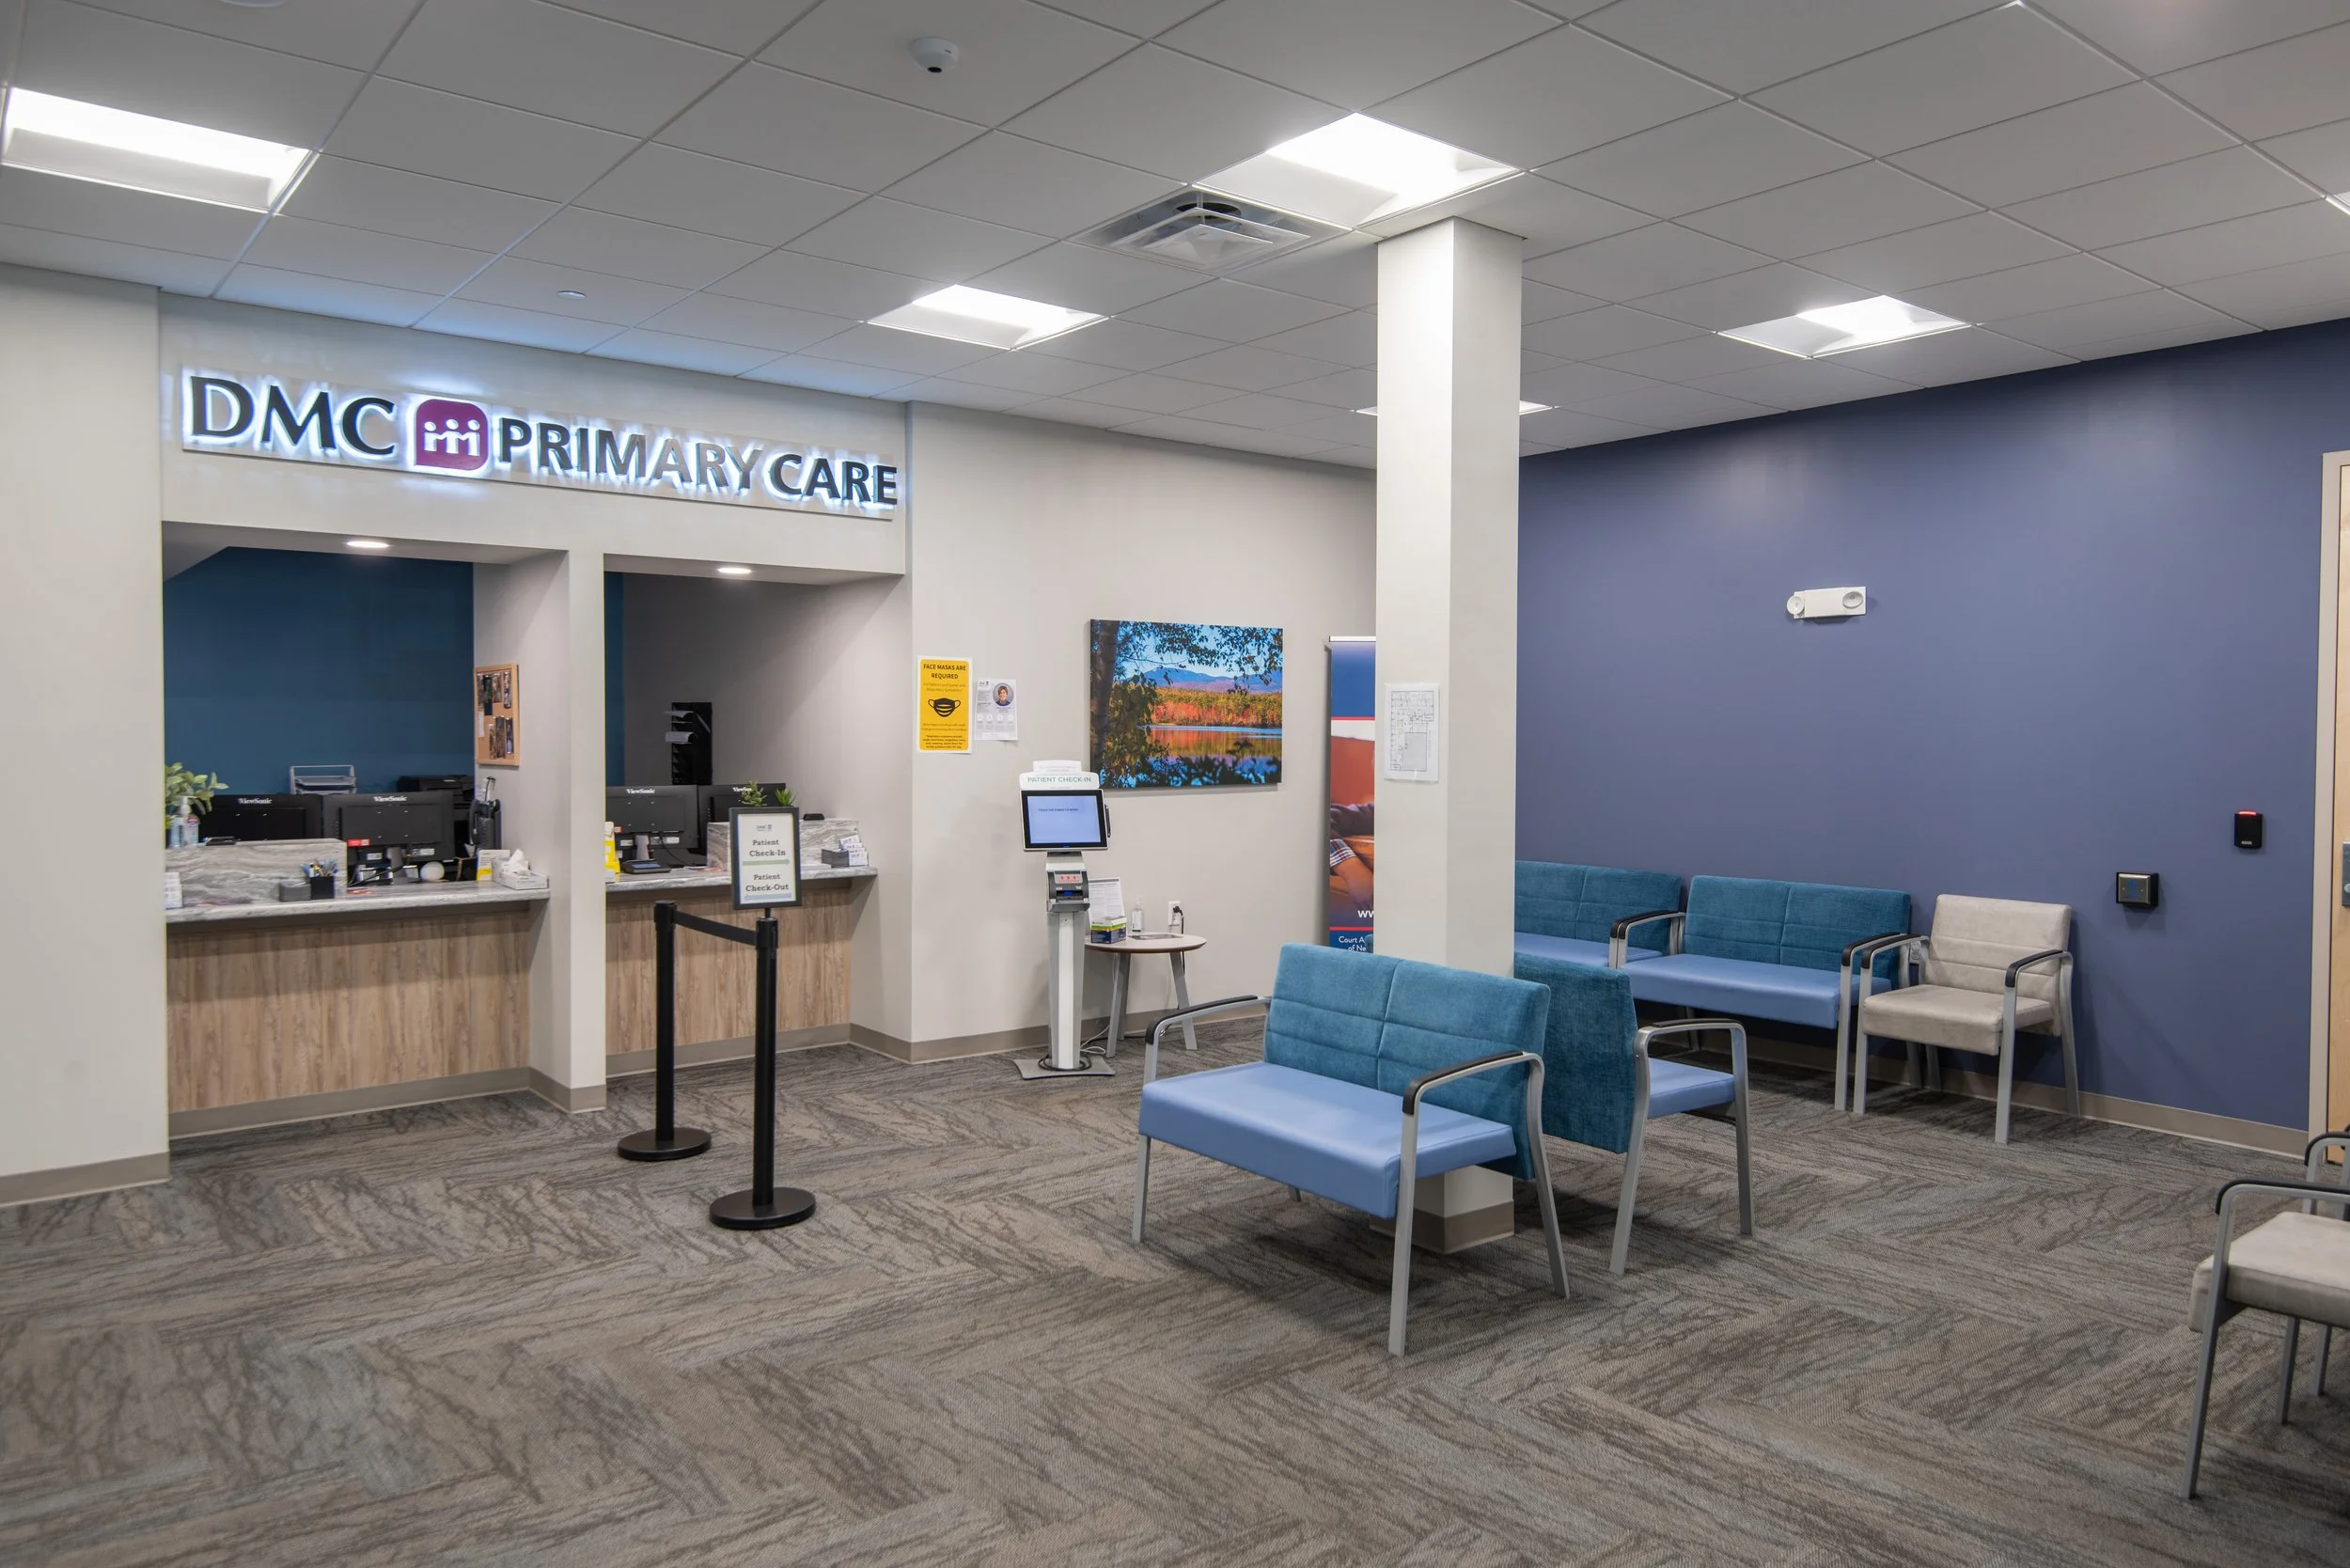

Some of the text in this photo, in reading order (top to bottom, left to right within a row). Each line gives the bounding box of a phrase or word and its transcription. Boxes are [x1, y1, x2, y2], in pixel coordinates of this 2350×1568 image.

[190, 375, 396, 456] DMC
[498, 416, 898, 506] PRIMARY CARE
[931, 672, 959, 681] REQUIRED
[749, 849, 786, 857] Check-In
[745, 883, 790, 892] Check-Out
